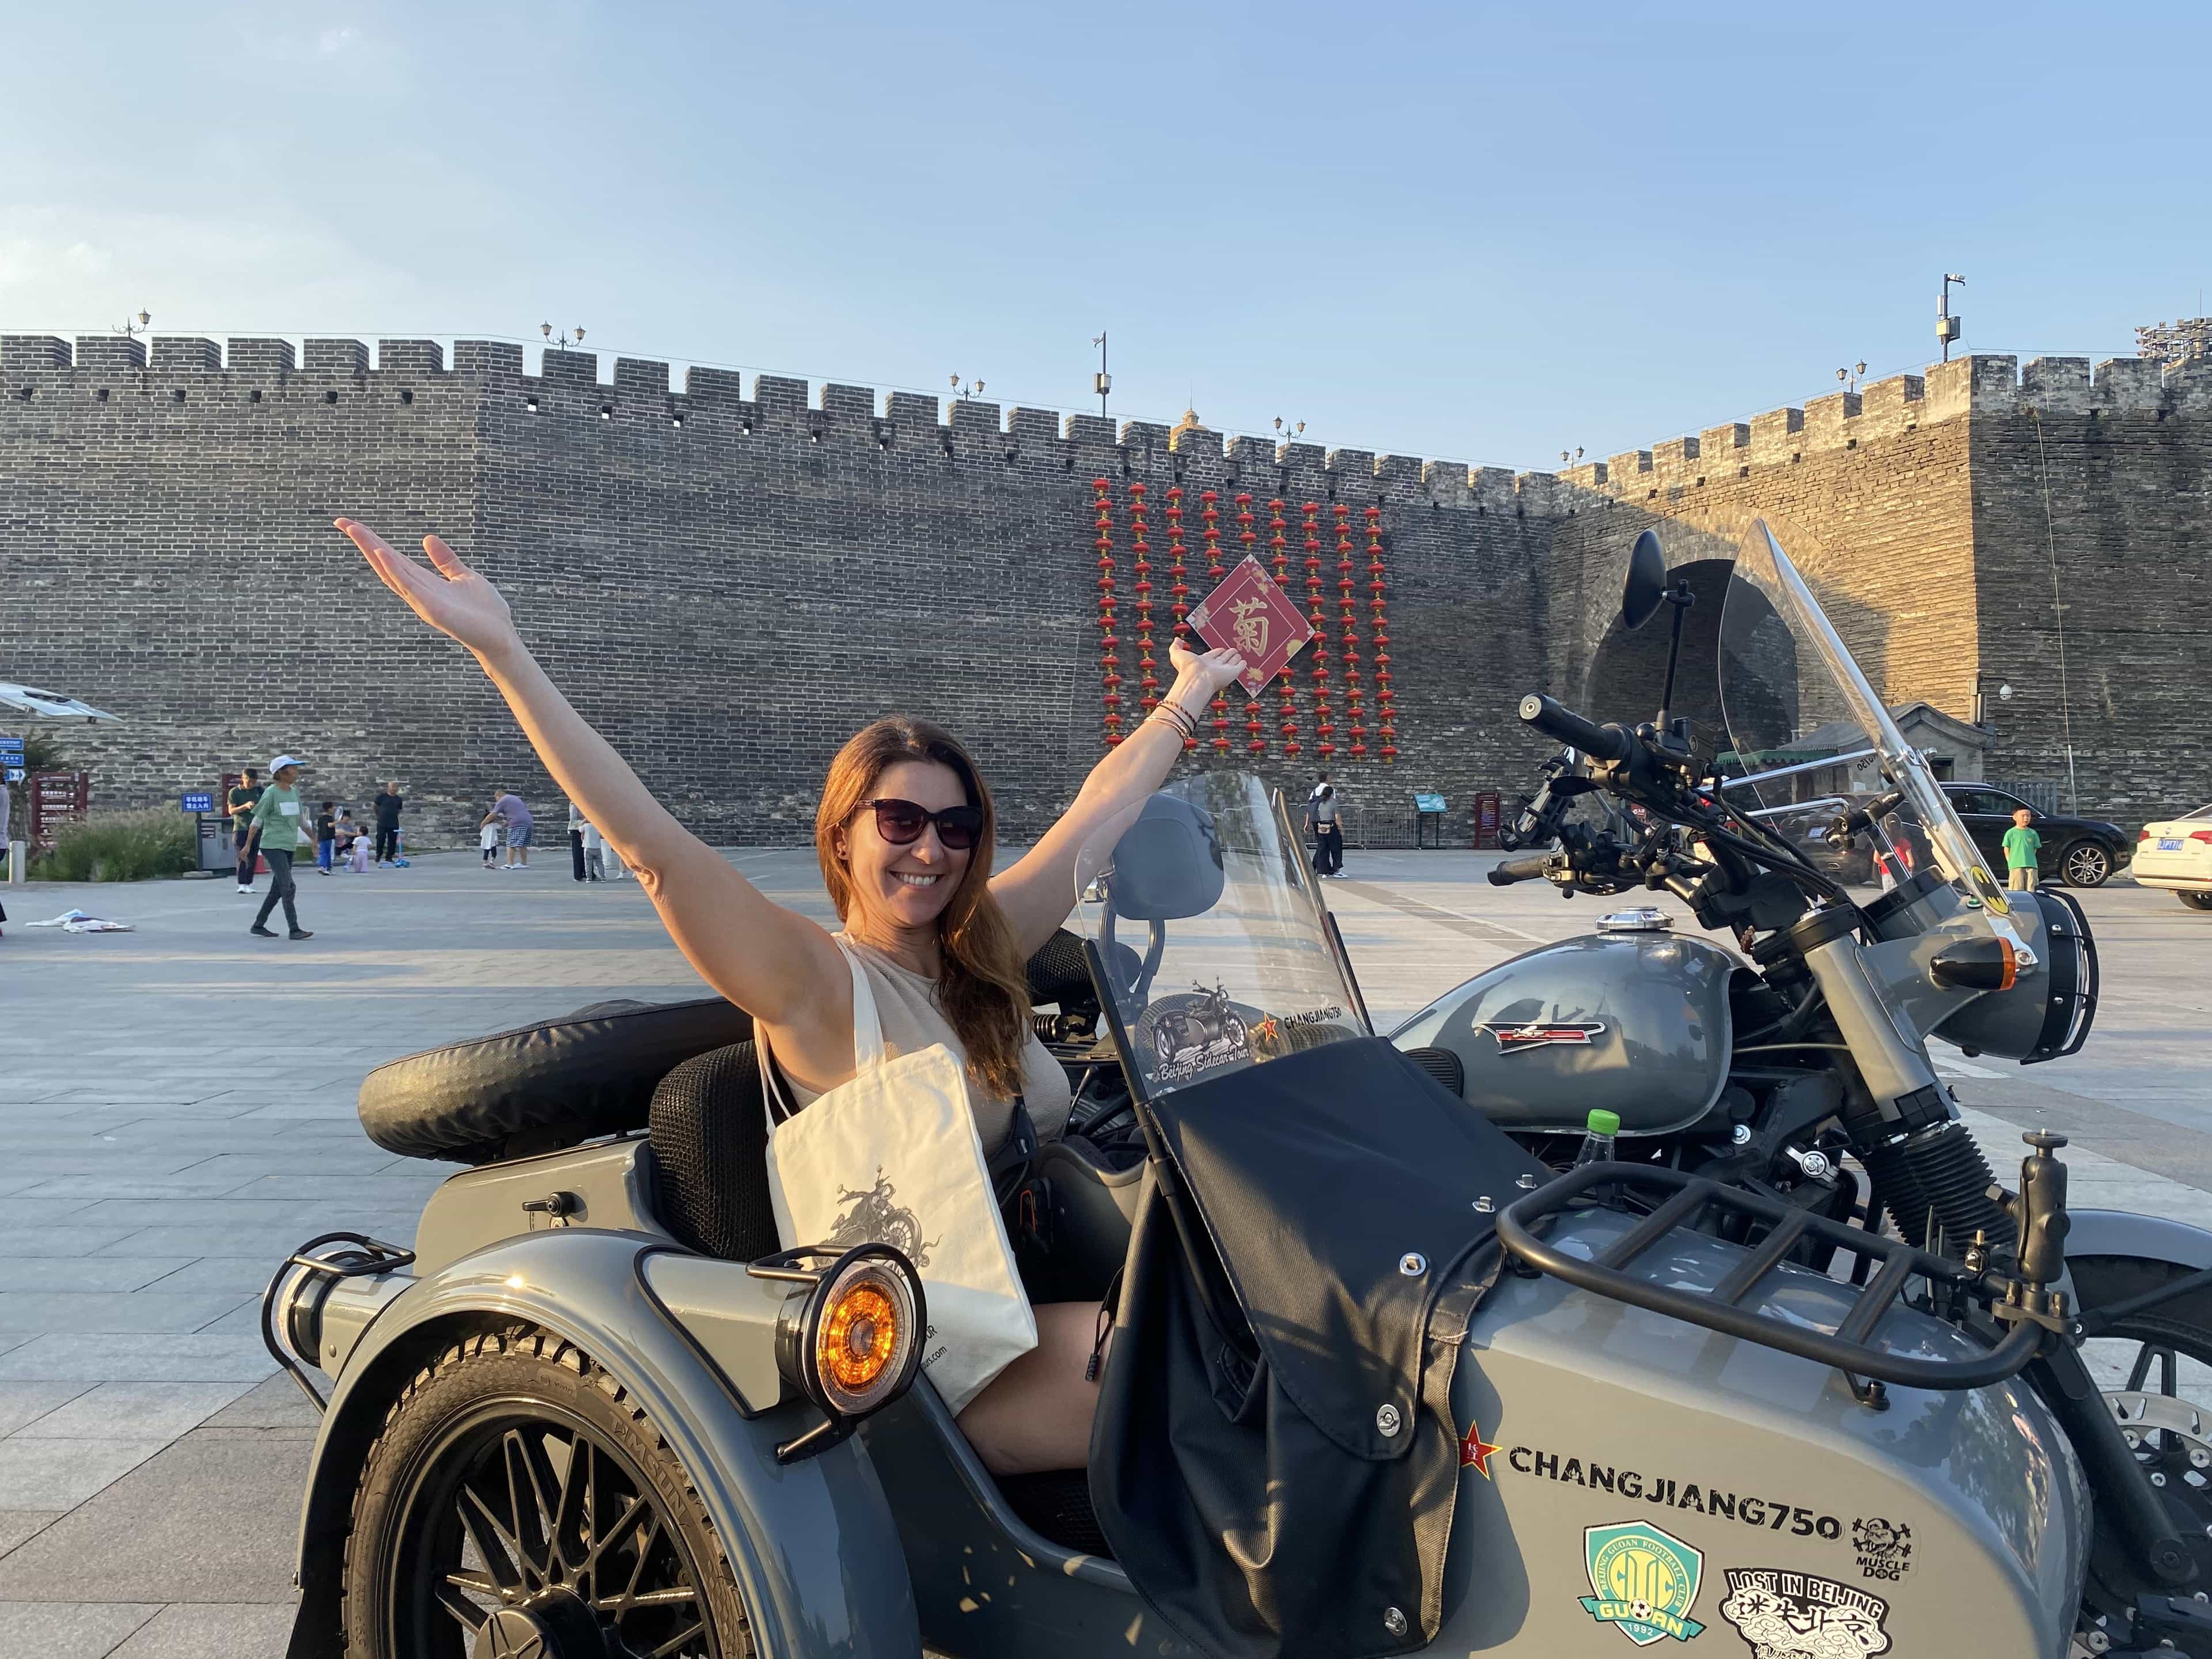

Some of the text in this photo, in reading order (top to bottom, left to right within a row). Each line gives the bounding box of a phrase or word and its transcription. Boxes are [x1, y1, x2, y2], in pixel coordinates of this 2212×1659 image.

[1229, 597, 1269, 657] 菊
[1284, 1006, 1342, 1029] CHANGJIANG750
[1158, 1062, 1193, 1082] Beijing
[1509, 1446, 1842, 1540] CHANGJIANG750
[1597, 1539, 1686, 1608] BEIJING GUOAN FOOTBALL CLUB
[1856, 1556, 1910, 1571] MUSCLE
[1863, 1566, 1900, 1581] DOG
[1728, 1571, 1885, 1621] LOST IN BEIJING
[1628, 1623, 1654, 1637] 1992
[1736, 1593, 1872, 1645] 迷失北京
